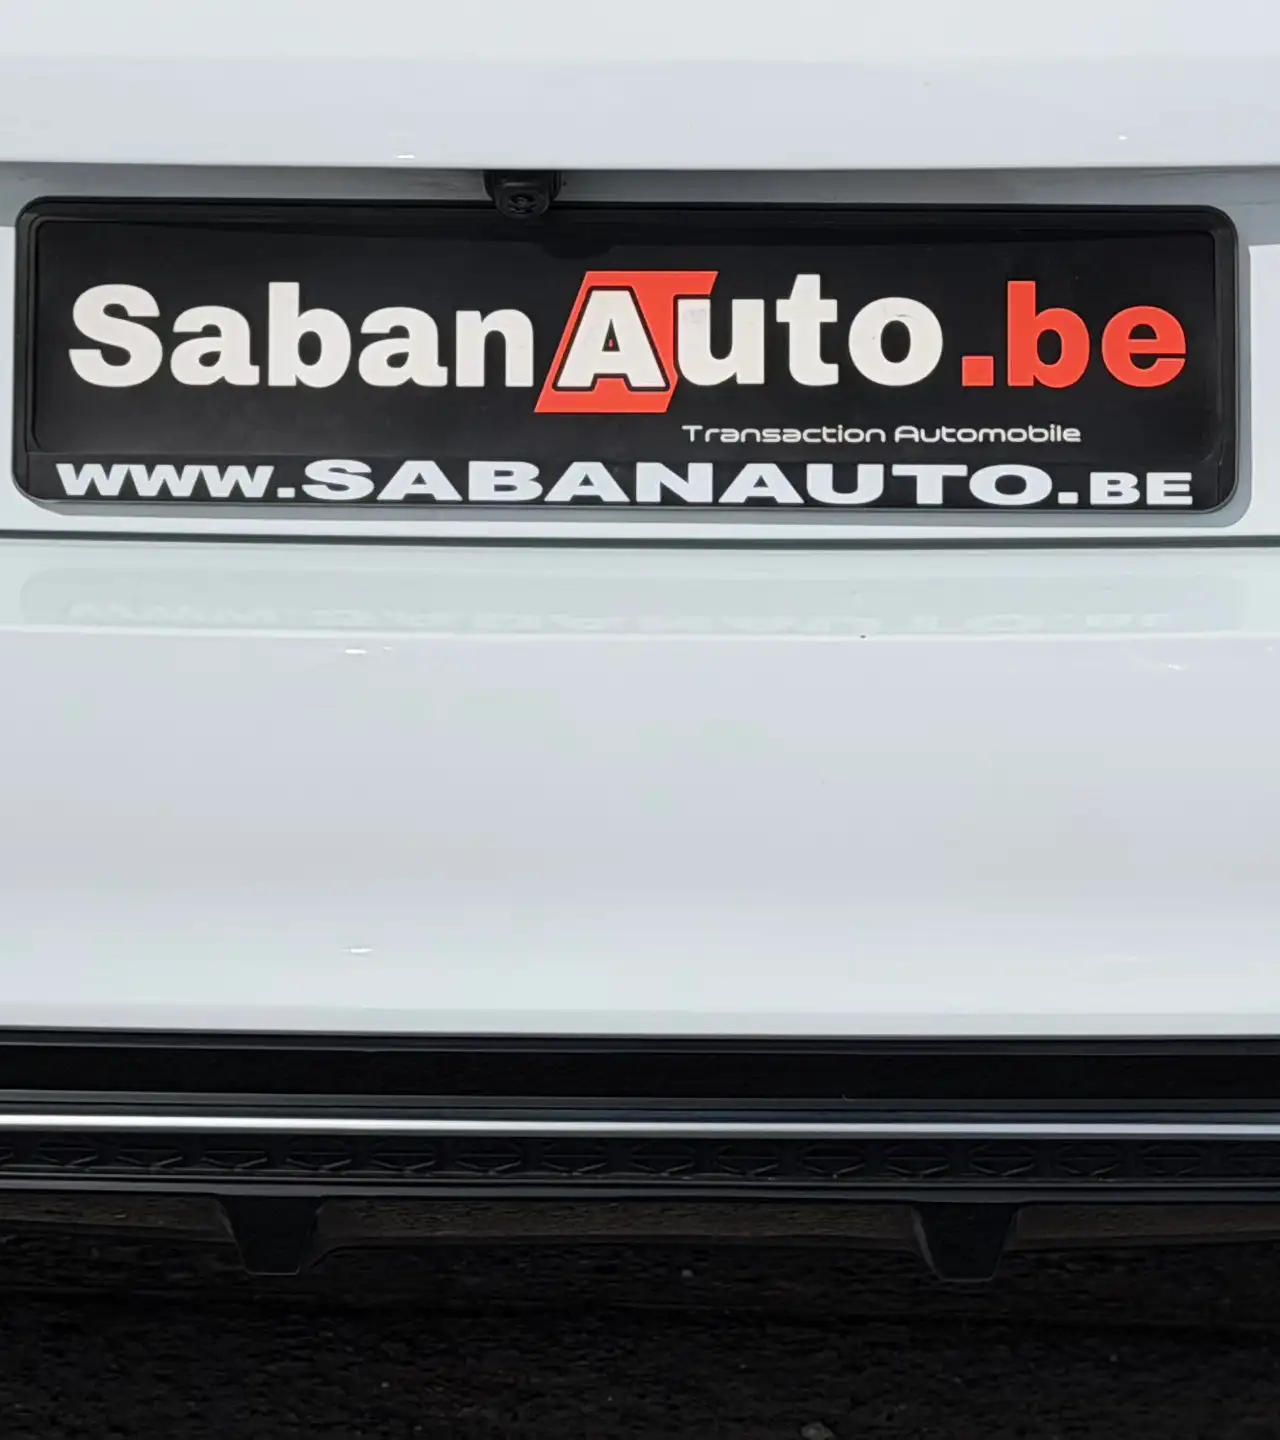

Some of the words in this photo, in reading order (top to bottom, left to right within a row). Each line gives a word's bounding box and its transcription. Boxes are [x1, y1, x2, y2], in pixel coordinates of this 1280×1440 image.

[68, 273, 1186, 389] SabanAuto.be
[682, 424, 886, 444] Transaction
[894, 424, 1081, 444] Automobile
